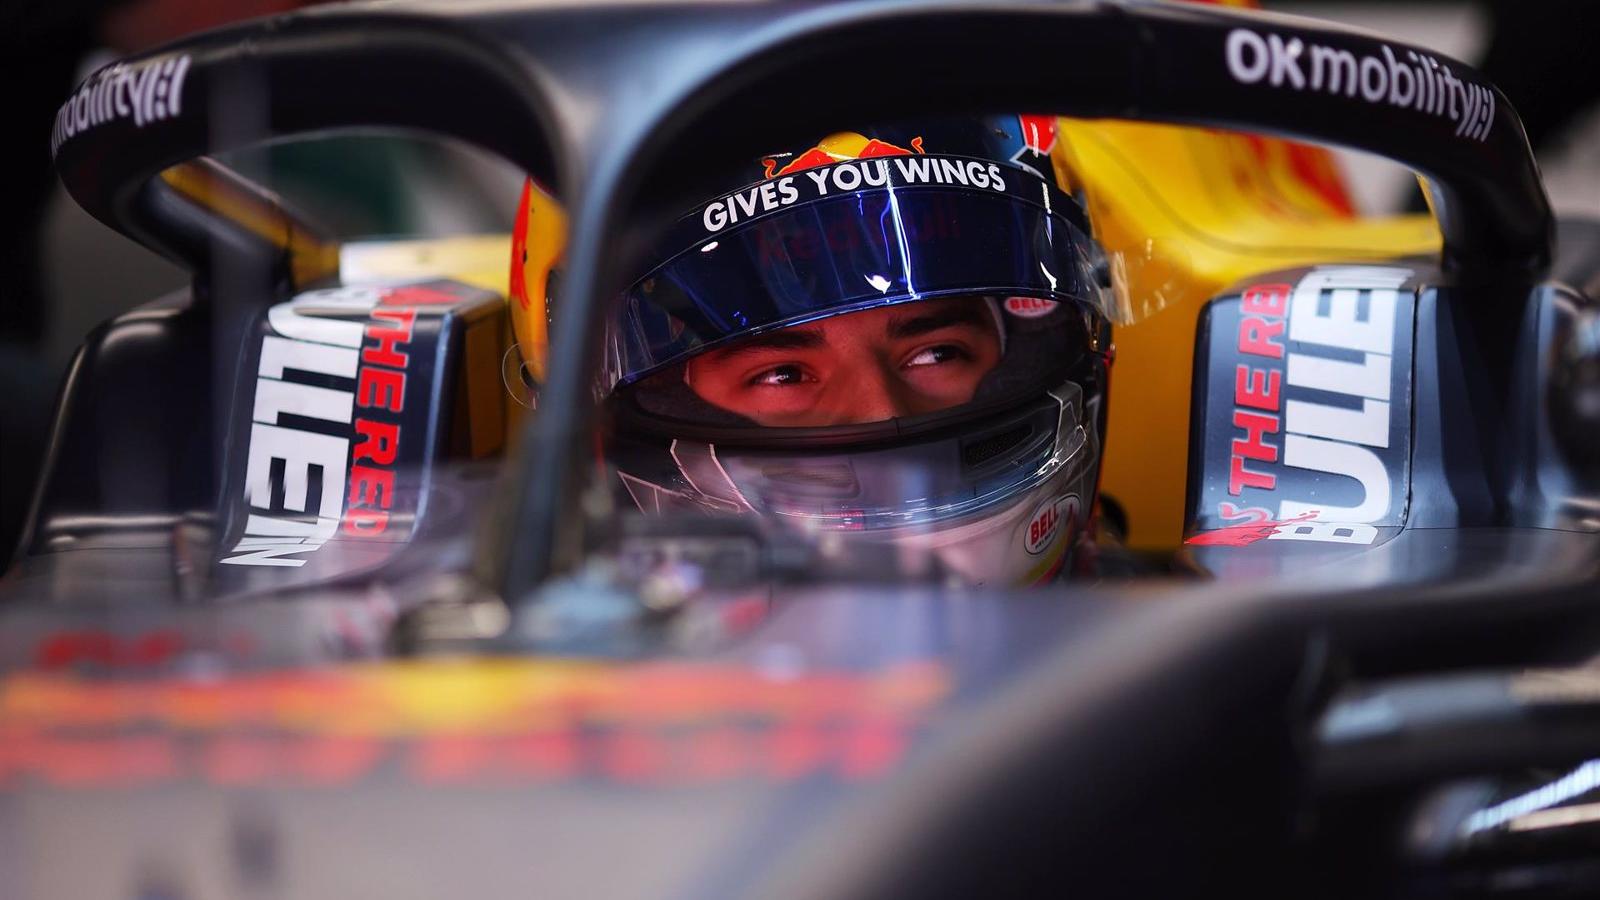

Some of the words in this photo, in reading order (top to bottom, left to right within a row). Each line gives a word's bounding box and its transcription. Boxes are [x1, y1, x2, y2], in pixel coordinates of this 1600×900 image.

[703, 177, 799, 232] GIVES
[807, 160, 890, 196] YOU
[895, 158, 1006, 192] WINGS
[1009, 298, 1054, 311] BELL
[357, 307, 416, 413] THE
[1228, 364, 1281, 496] THE
[343, 417, 400, 537] RED
[1030, 503, 1058, 545] BELL
